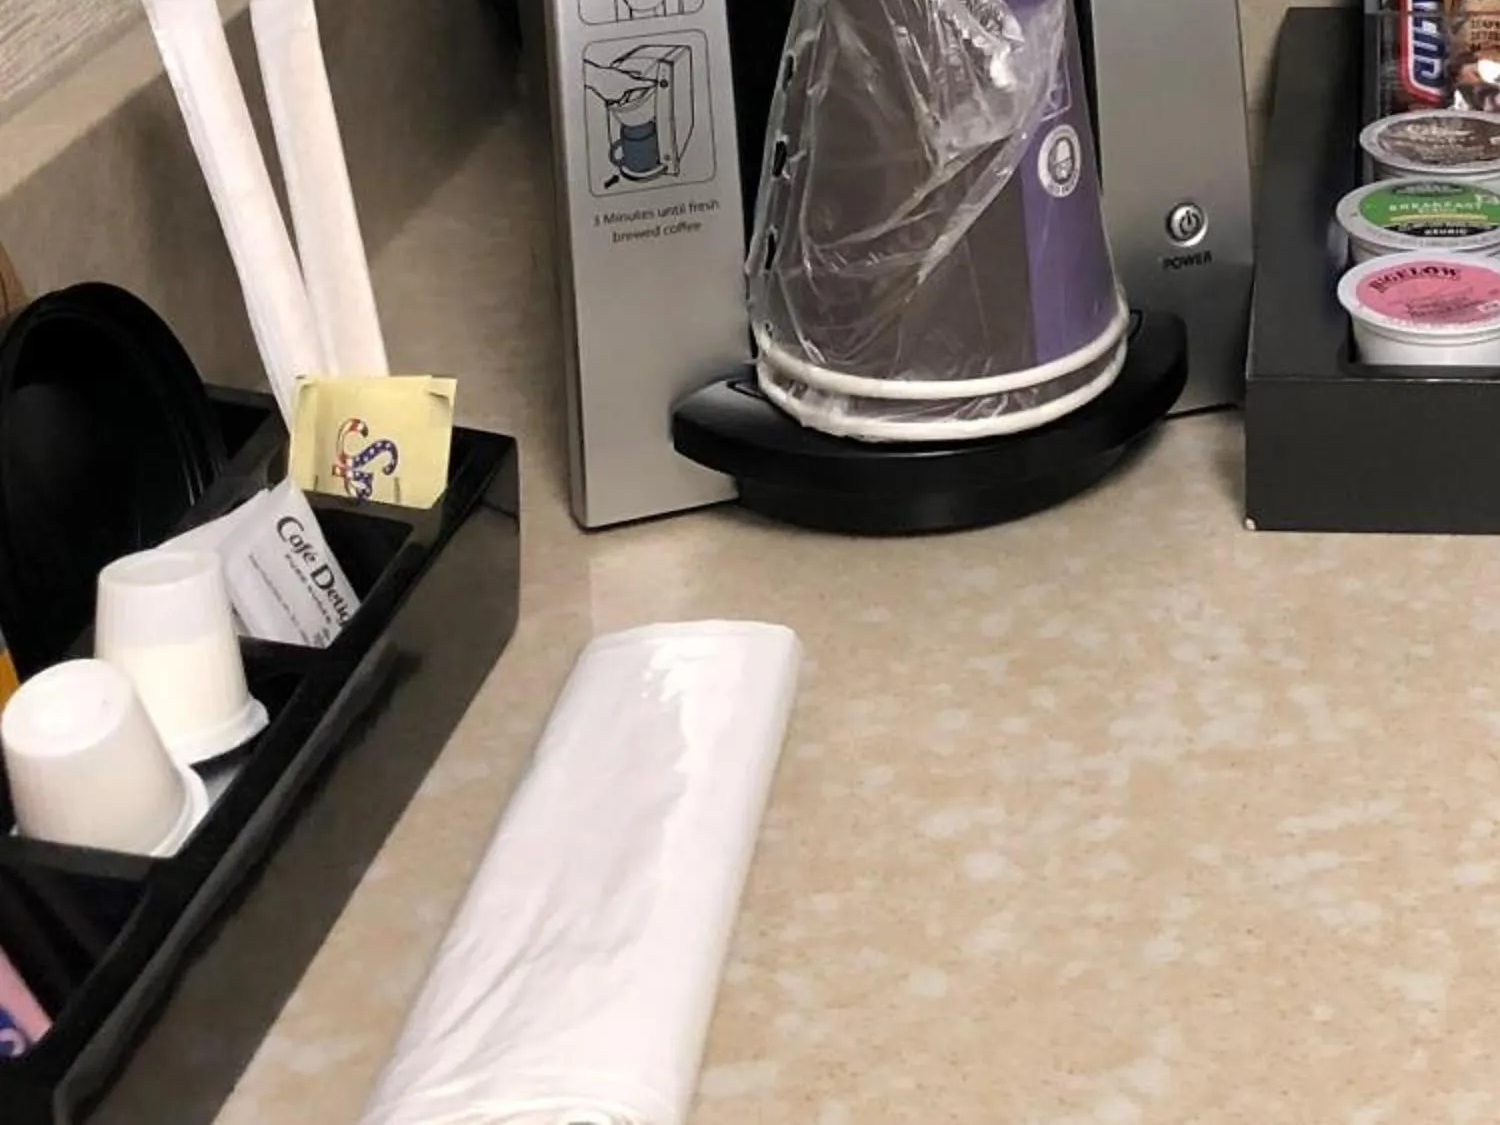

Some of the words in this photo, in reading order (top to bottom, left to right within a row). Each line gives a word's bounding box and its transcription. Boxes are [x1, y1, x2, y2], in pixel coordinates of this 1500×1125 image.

[603, 210, 655, 224] Minutes
[658, 202, 687, 218] until
[689, 199, 720, 214] fresh
[612, 225, 660, 243] brewed
[663, 221, 702, 236] coffee
[1162, 250, 1213, 271] POWER
[1369, 266, 1462, 294] BIGELOW
[276, 516, 317, 564] Café
[309, 564, 351, 627] Delig
